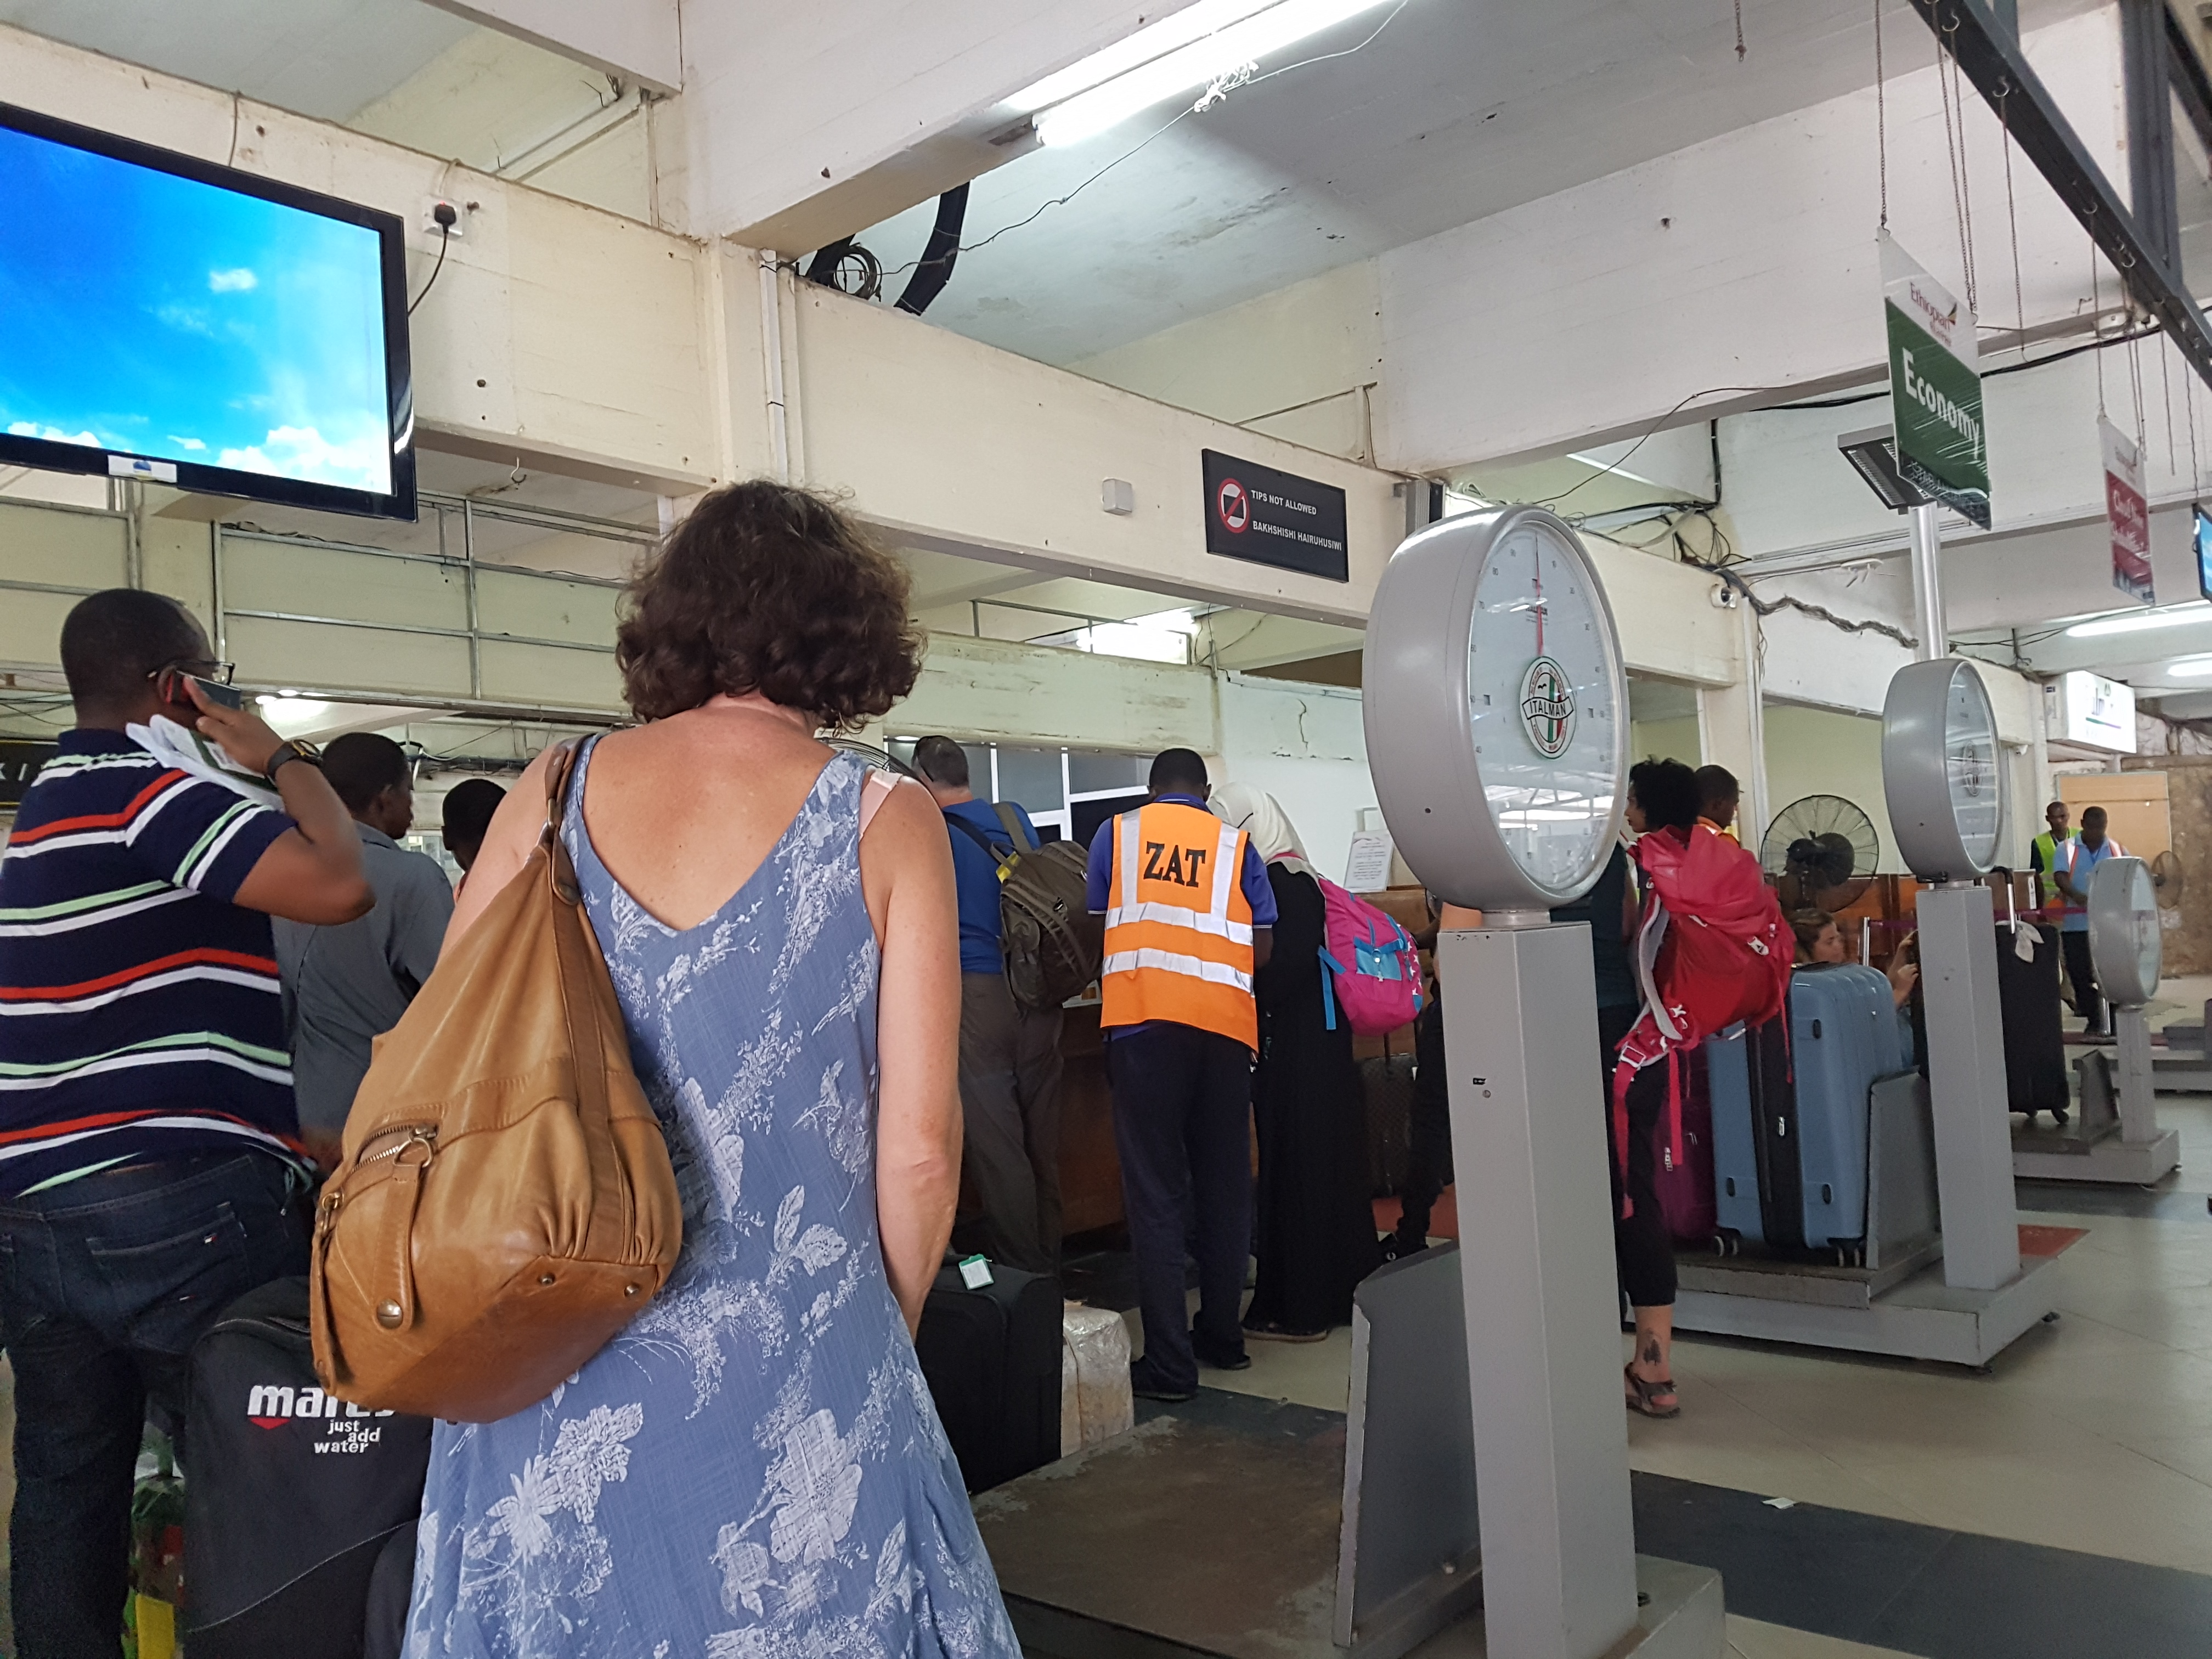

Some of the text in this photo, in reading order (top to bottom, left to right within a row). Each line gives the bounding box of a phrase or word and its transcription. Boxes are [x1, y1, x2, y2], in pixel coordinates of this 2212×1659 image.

[1902, 347, 1979, 459] Economy
[1251, 489, 1317, 515] TIPS NOT ALLOWED
[1252, 521, 1342, 551] BAKHSHISHI HAIRUHUSIWI
[1530, 700, 1566, 717] ITALMAN
[1143, 841, 1206, 888] ZAT
[247, 1385, 396, 1418] mar
[328, 1419, 360, 1435] just
[348, 1427, 381, 1443] add
[314, 1441, 369, 1454] water
